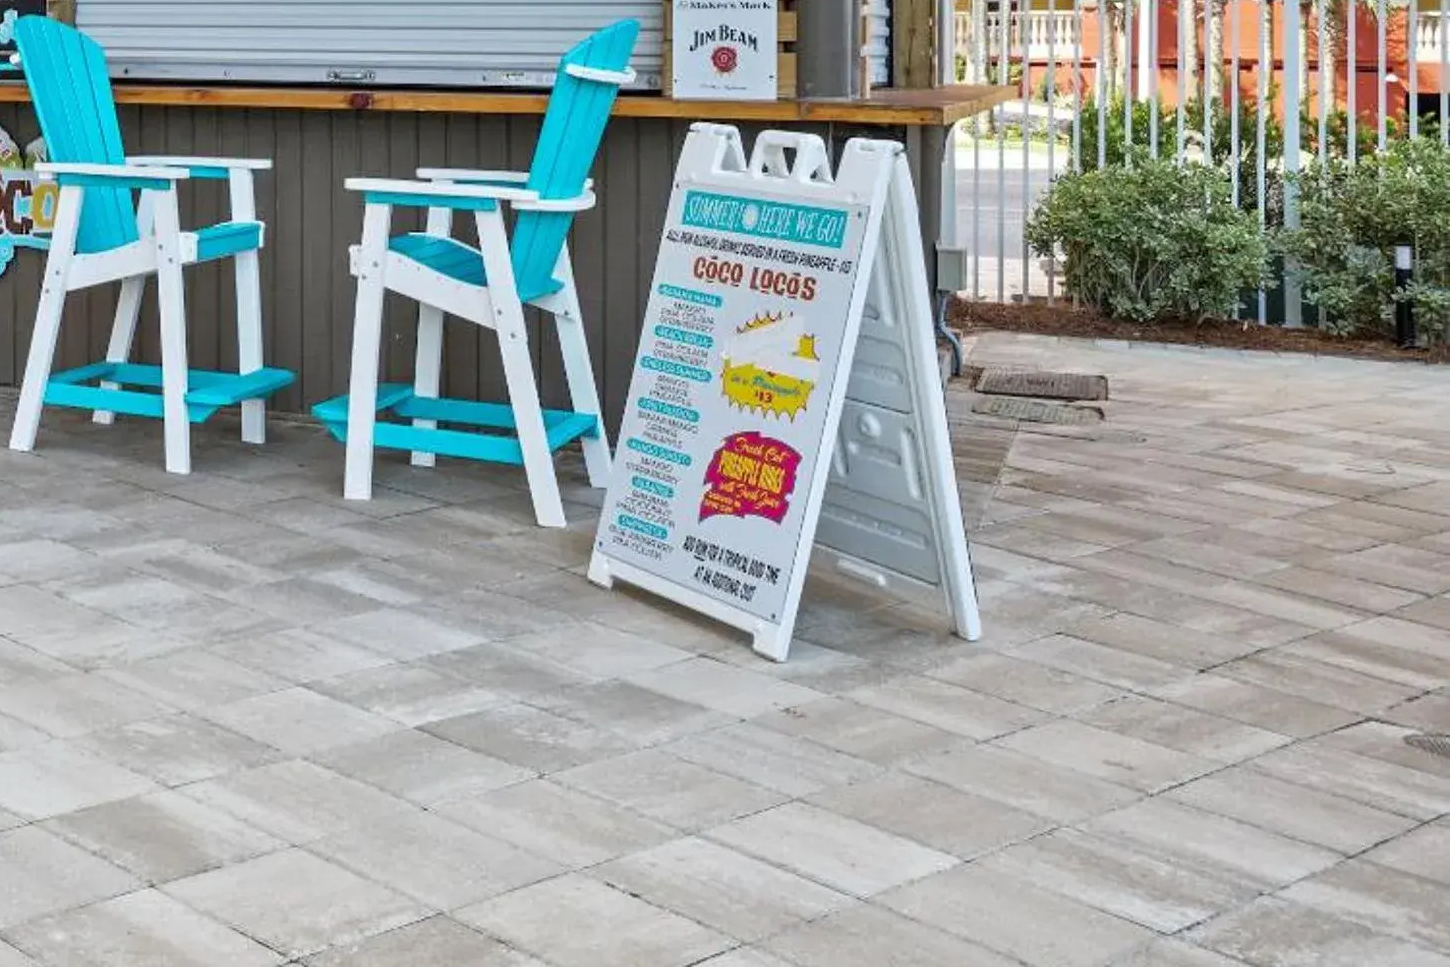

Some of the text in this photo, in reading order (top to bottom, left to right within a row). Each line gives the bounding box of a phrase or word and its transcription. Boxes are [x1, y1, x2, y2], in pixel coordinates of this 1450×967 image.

[690, 23, 759, 52] JIM BEAM
[686, 197, 844, 243] SUMMER! HERE WE GO!
[693, 256, 817, 301] COCO LOCOS
